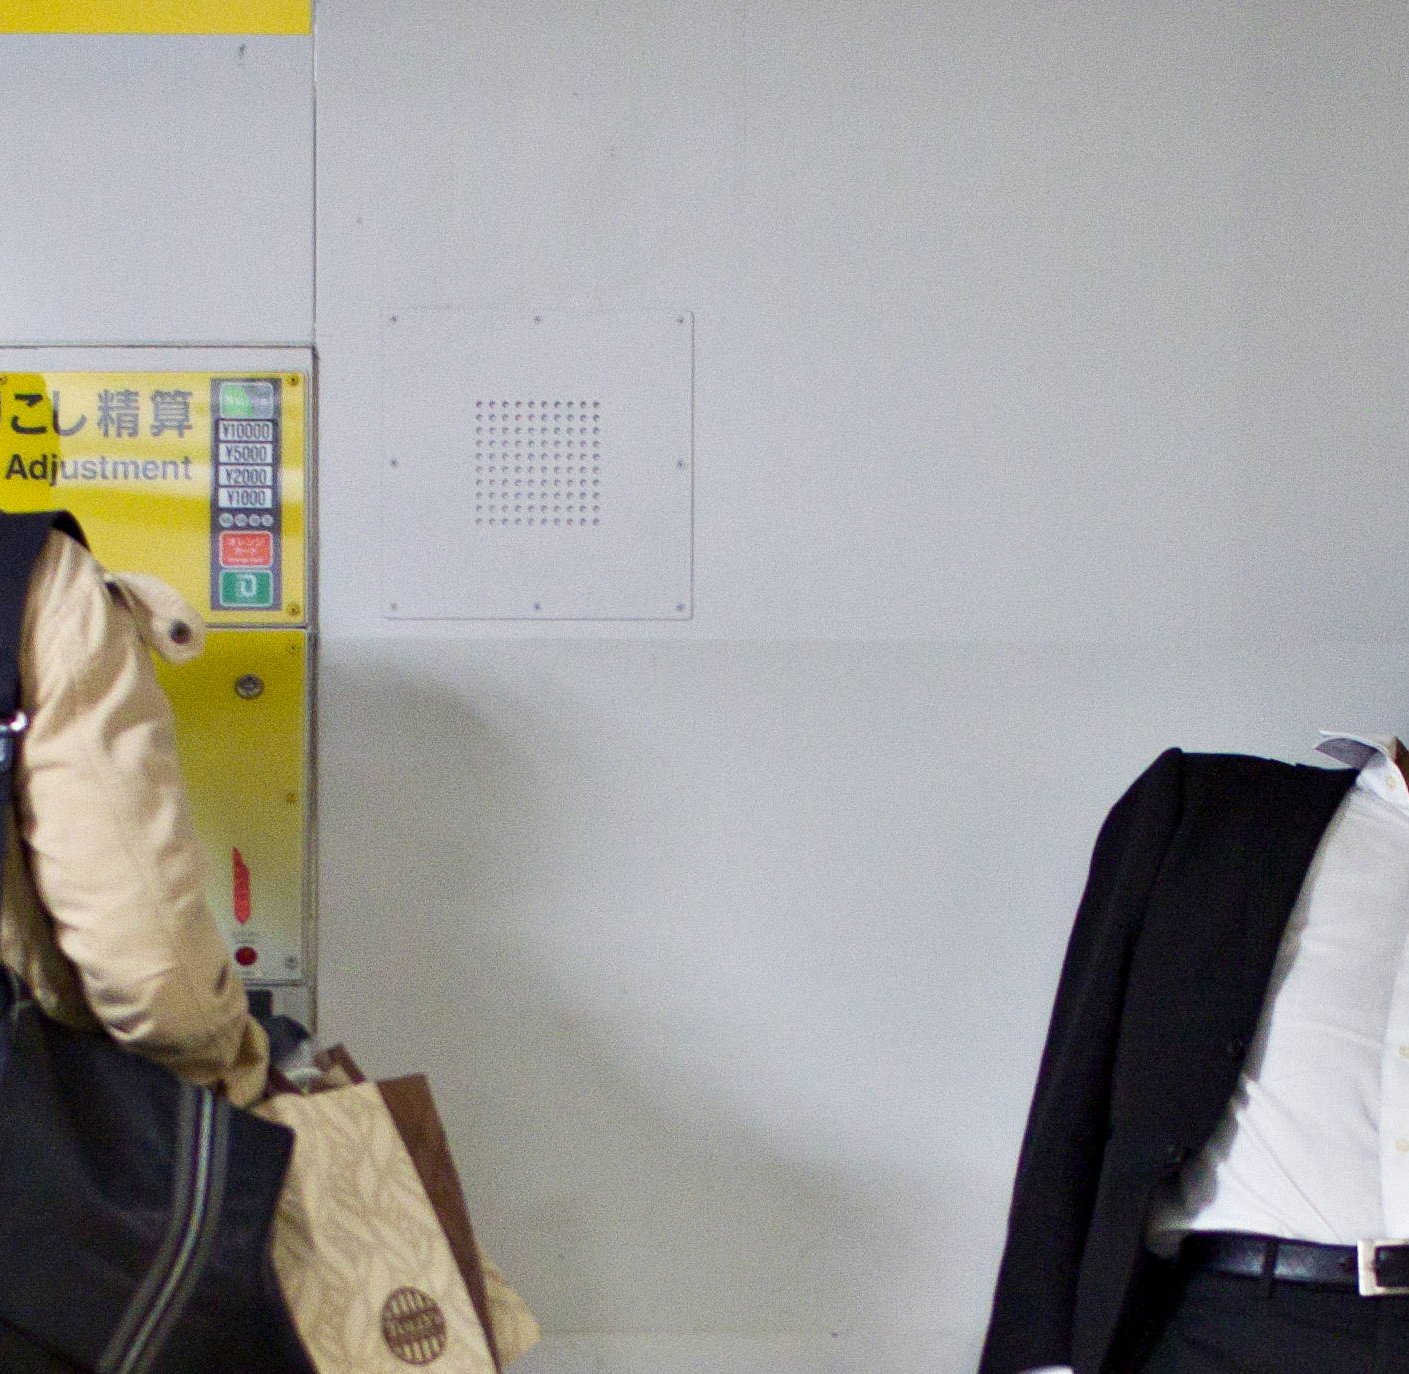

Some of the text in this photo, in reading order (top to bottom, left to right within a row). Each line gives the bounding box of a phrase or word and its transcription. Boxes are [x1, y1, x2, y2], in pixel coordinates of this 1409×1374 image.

[222, 422, 271, 440] ¥10000
[226, 445, 268, 462] ¥5000
[5, 454, 192, 486] Adjustment
[226, 468, 267, 485] ¥2000
[227, 490, 266, 506] ¥1000
